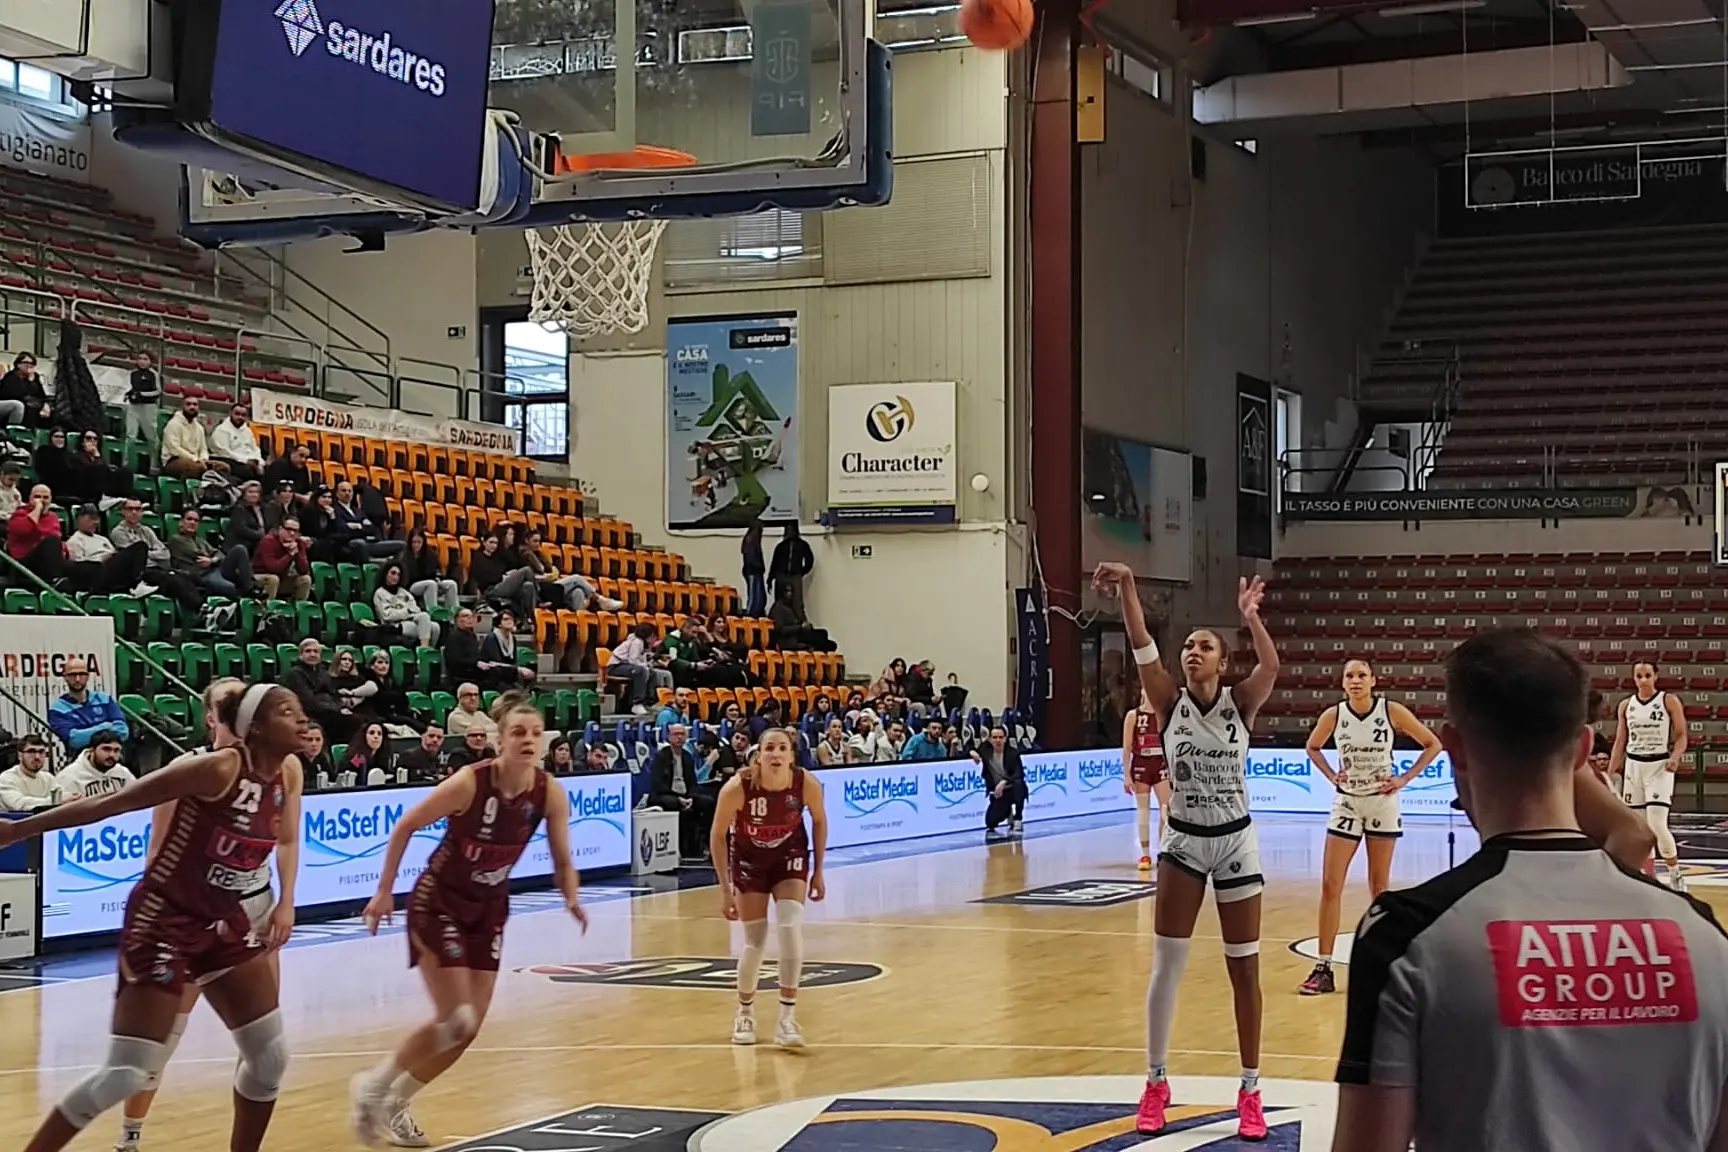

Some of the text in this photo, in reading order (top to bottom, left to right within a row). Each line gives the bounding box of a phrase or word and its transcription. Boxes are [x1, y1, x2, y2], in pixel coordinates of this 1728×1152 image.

[326, 19, 446, 97] sardares
[1586, 163, 1603, 182] di
[676, 349, 709, 361] CASA
[275, 402, 354, 430] SARDEGNA
[450, 428, 514, 450] SARDEGNA
[841, 452, 943, 473] Character
[1285, 500, 1296, 511] IL
[1299, 500, 1341, 511] TASSO
[1355, 498, 1377, 510] PIÙ
[1380, 499, 1475, 511] CONVENIENTE
[1477, 498, 1507, 509] CON
[1511, 498, 1540, 509] UNA
[1543, 498, 1580, 509] CASA
[1582, 497, 1631, 508] GREEN
[0, 653, 101, 678] RDEGA
[1649, 711, 1664, 721] 42
[1226, 723, 1239, 743] 2
[1373, 728, 1389, 743] 21
[1245, 757, 1311, 776] edical
[844, 775, 918, 802] MaStef Medical
[934, 770, 966, 794] MaStef
[231, 778, 263, 814] 23
[569, 786, 625, 817] Medical
[748, 796, 768, 817] 18
[482, 796, 499, 824] 9
[305, 805, 381, 842] MaStef
[1337, 816, 1355, 831] 21
[58, 823, 152, 866] MaStef
[1516, 923, 1672, 968] ATTAL
[1516, 971, 1677, 1003] GROUP
[1520, 1005, 1680, 1021] AGENZIE PER IL LAVORO
